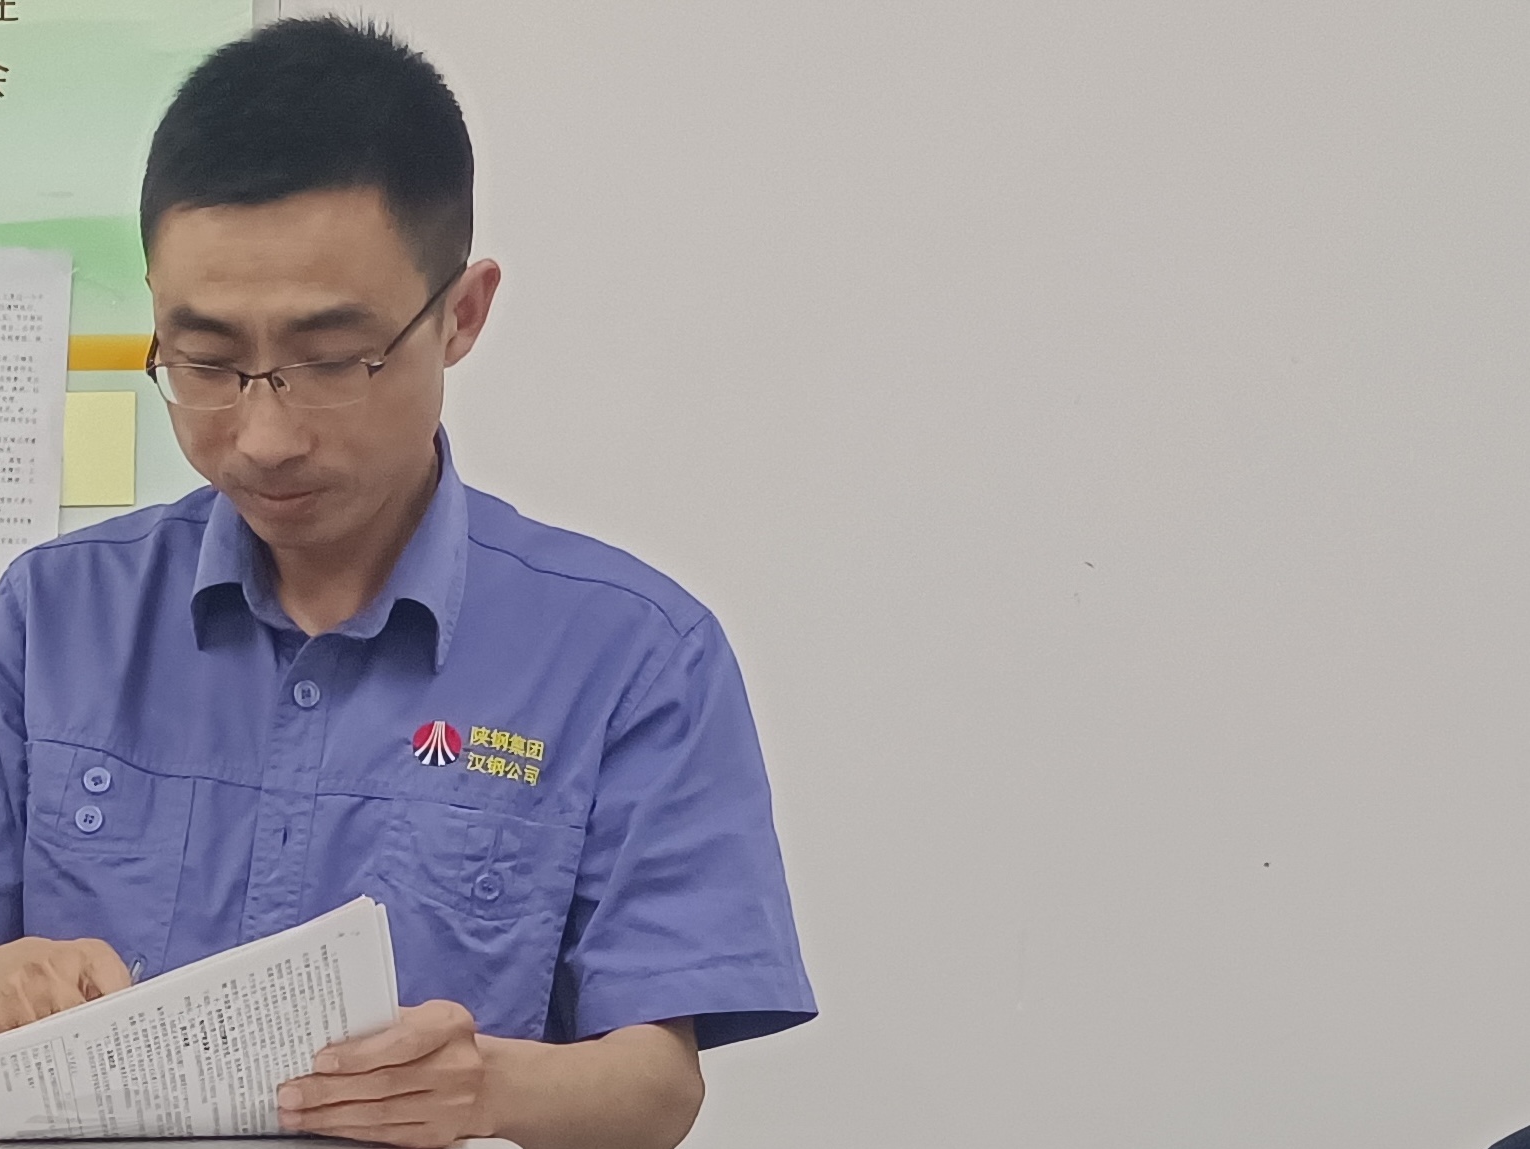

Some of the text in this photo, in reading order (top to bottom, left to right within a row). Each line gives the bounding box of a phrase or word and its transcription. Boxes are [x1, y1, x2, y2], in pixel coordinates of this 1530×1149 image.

[470, 725, 545, 761] 陕钢集团
[466, 751, 540, 787] 汉钢公司
